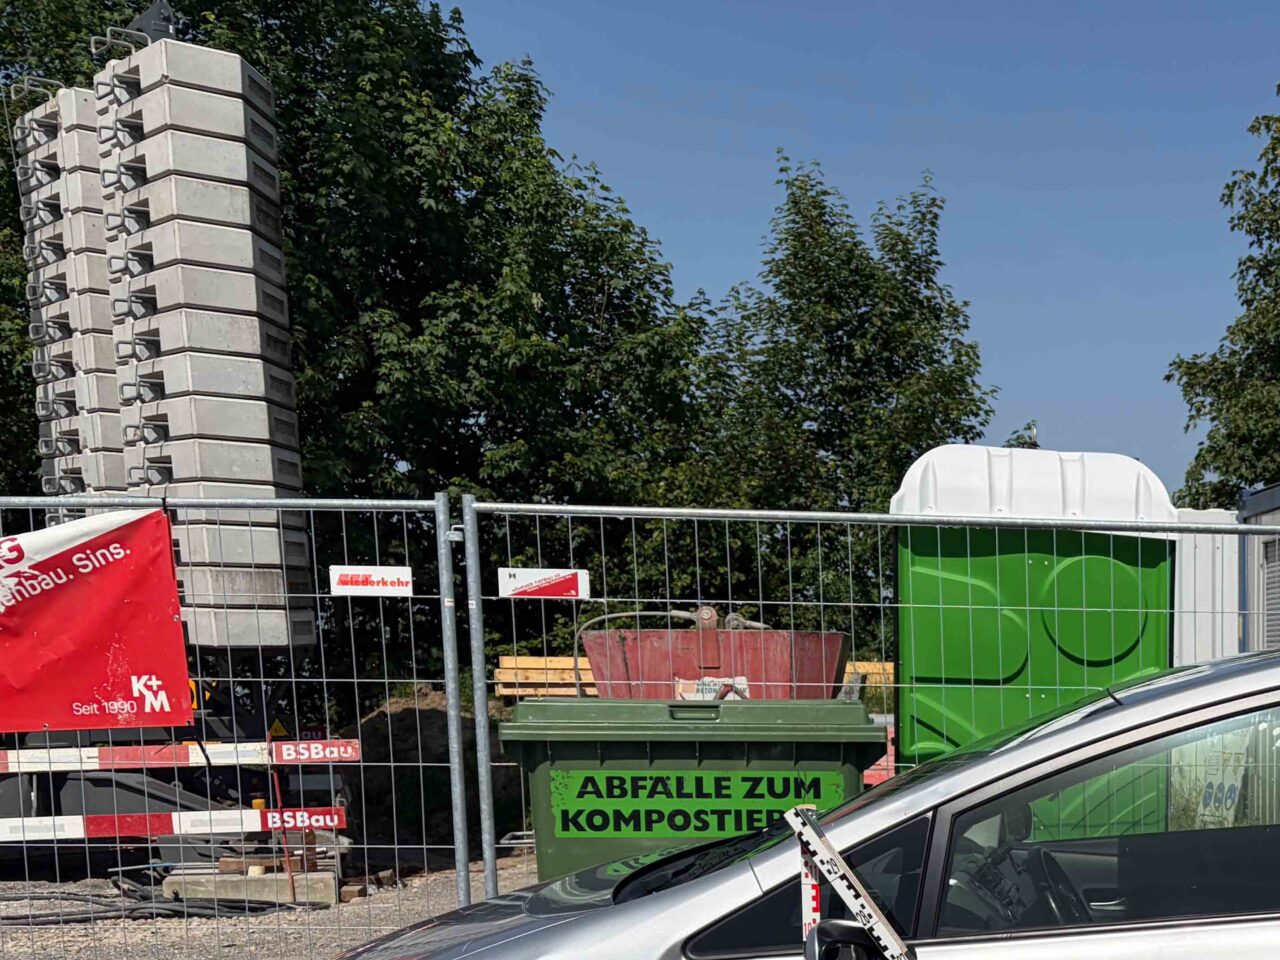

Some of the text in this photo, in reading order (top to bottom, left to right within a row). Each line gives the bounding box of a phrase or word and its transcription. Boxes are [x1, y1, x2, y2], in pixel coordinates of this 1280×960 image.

[0, 542, 131, 612] enbau. Sins.
[72, 700, 137, 715] Seit 1990
[281, 743, 353, 760] BSBau
[576, 775, 821, 799] ABFÄLLE ZUM
[267, 811, 338, 828] BSBau
[560, 808, 786, 832] KOMPOSTIER
[826, 857, 842, 875] 29
[856, 910, 870, 927] 28
